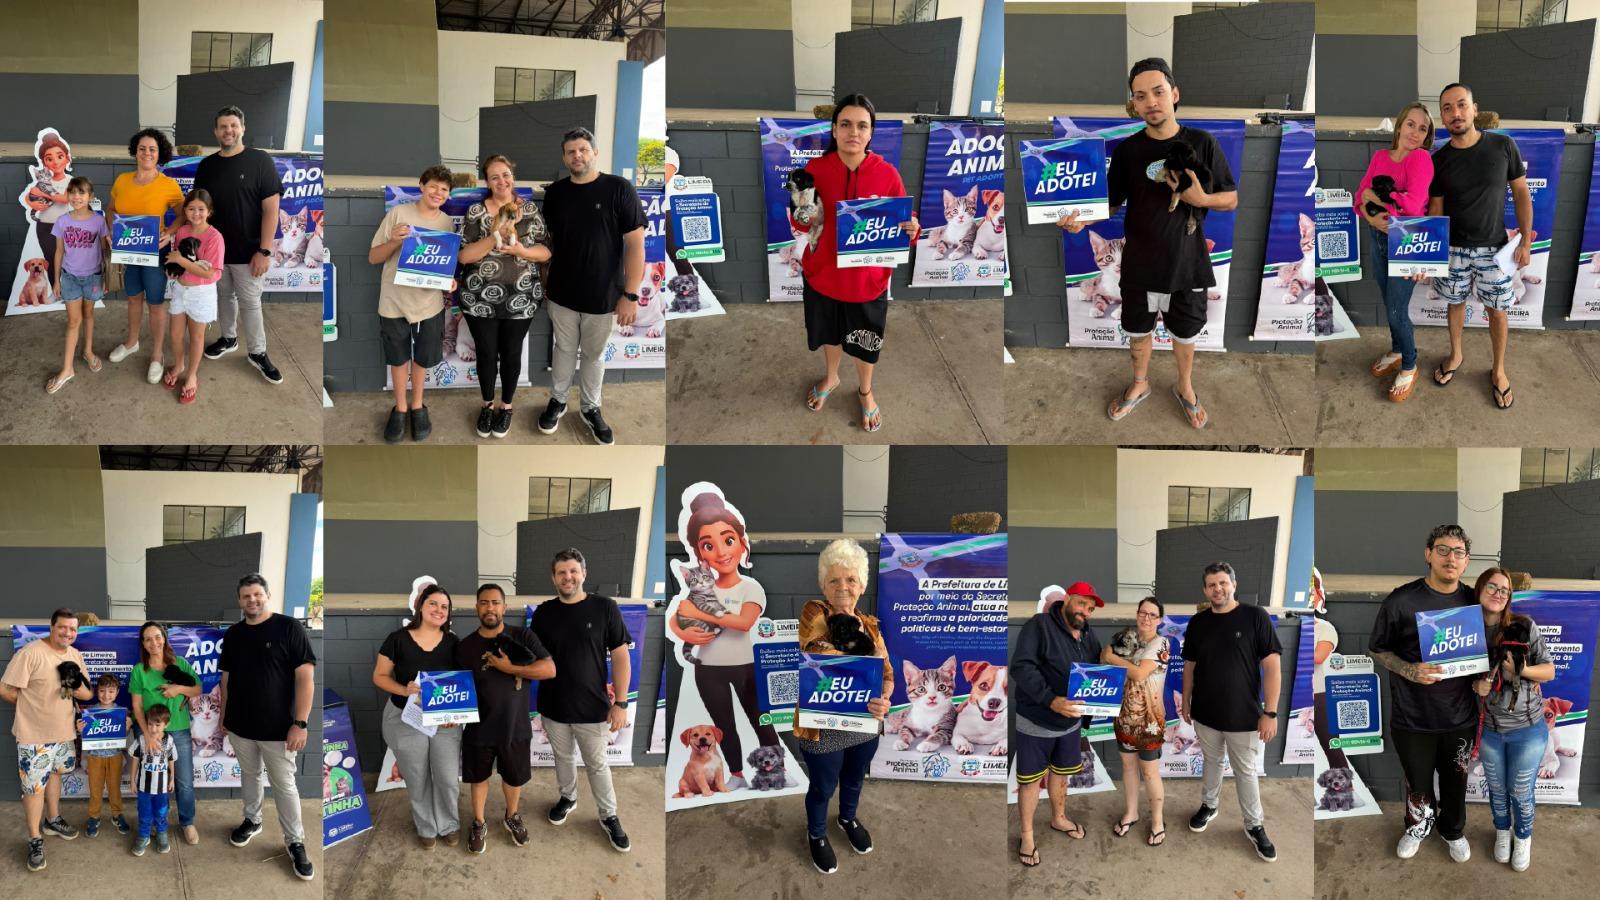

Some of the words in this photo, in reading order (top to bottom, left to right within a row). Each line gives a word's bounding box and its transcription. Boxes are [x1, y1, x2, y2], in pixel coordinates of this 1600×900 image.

[282, 167, 324, 183] ADO
[1041, 160, 1078, 181] #EU
[1034, 172, 1097, 195] ADOTEI
[853, 216, 886, 234] #EU
[123, 227, 143, 238] #EU
[1401, 232, 1428, 245] #EU
[414, 243, 440, 256] #EU
[1395, 240, 1441, 256] ADOTEI
[1084, 327, 1115, 335] Proteção
[922, 580, 929, 588] A
[931, 580, 982, 588] Prefeitura
[983, 580, 996, 588] de
[918, 592, 934, 601] por
[943, 624, 956, 633] de
[957, 624, 1008, 633] bem-estar
[1434, 625, 1462, 644] #EU
[1429, 633, 1478, 656] ADOTEI
[816, 676, 854, 692] #EU
[1081, 678, 1107, 690] #EU
[432, 684, 457, 698] #EU
[808, 689, 871, 704] ADOTEI
[428, 691, 470, 706] ADOTEI
[92, 718, 112, 728] #EU
[143, 763, 167, 771] CAIXA
[886, 760, 919, 768] Proteção
[892, 765, 919, 773] Animal
[324, 797, 361, 816] INHA
